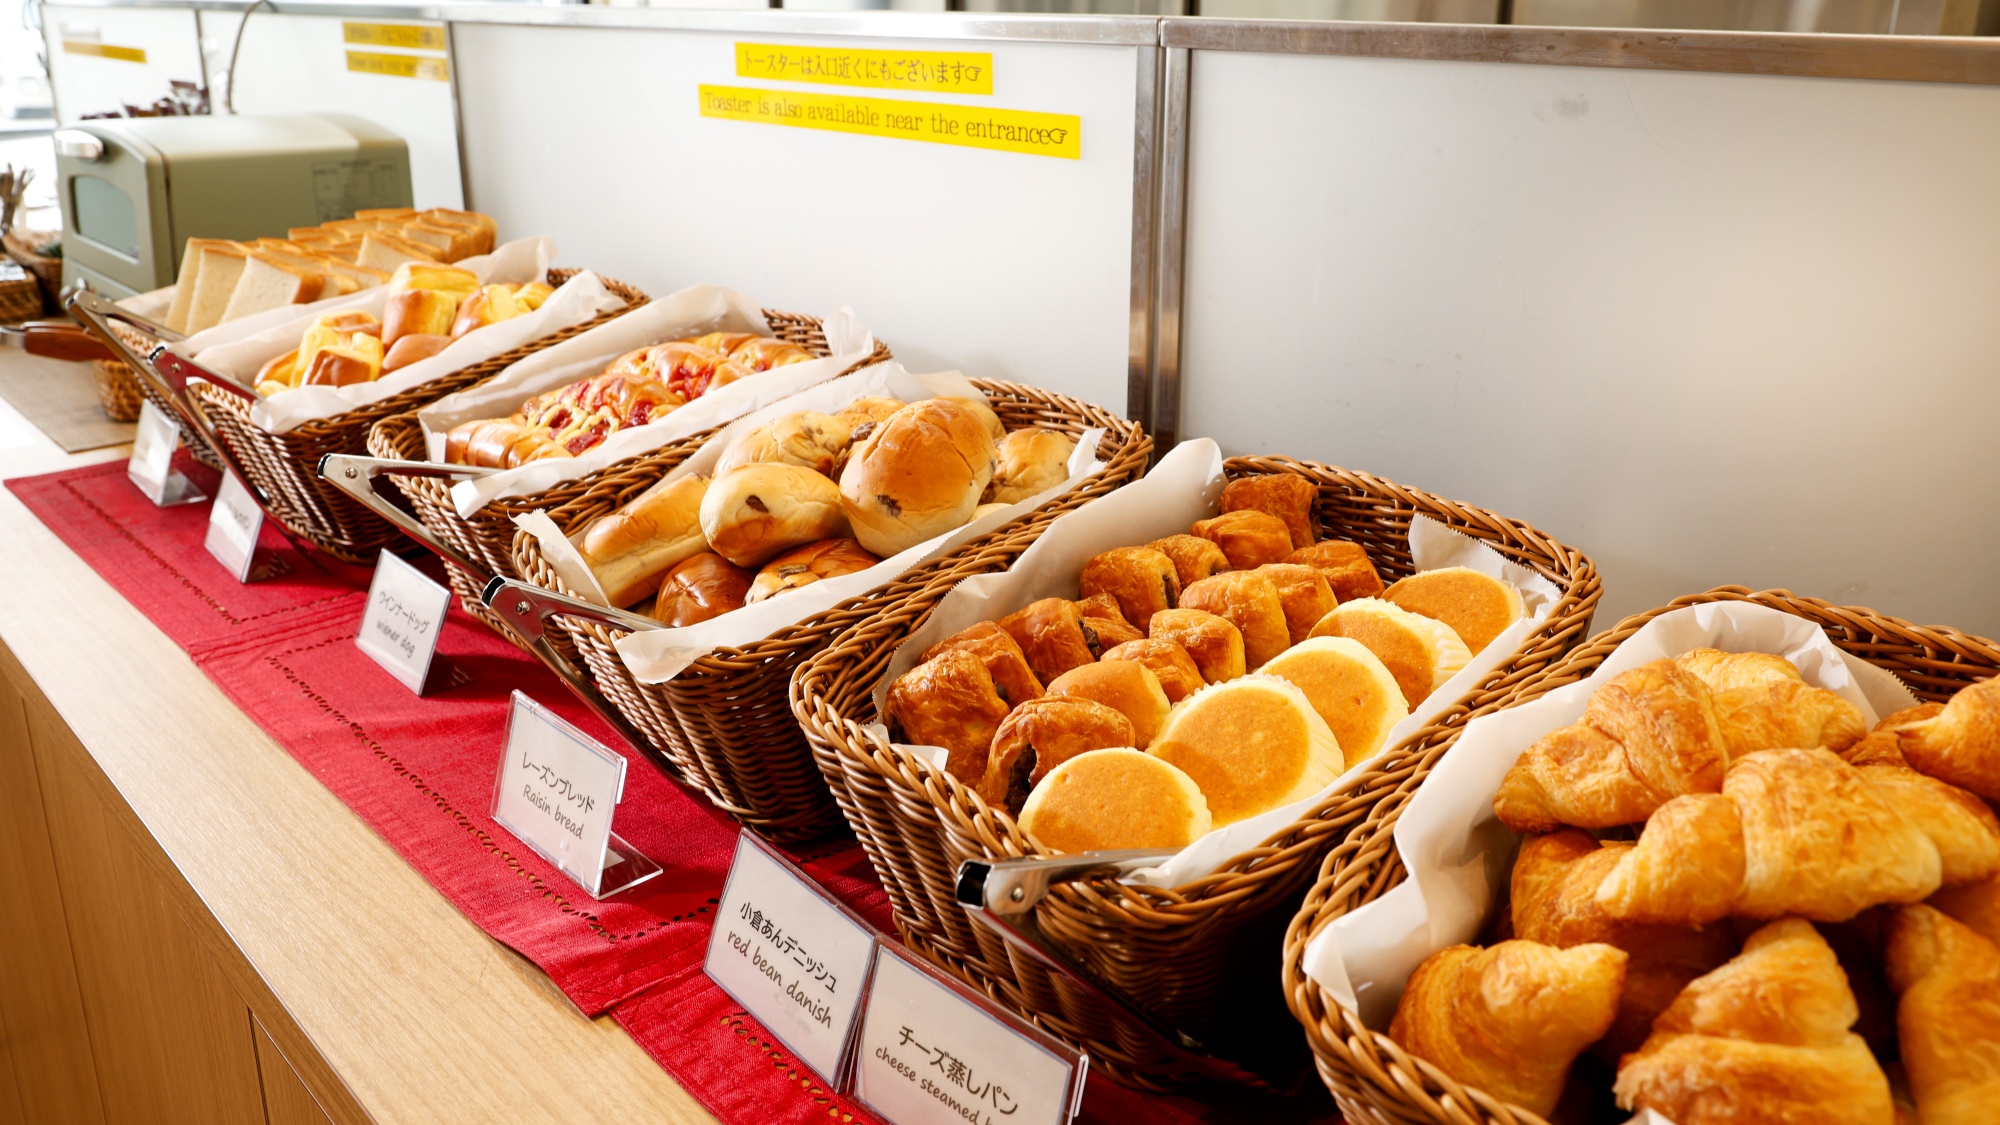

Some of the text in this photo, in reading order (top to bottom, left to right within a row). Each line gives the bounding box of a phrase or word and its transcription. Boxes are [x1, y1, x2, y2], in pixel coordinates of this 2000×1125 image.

[745, 50, 965, 85] トースターは入口近くにもございます
[704, 91, 1050, 145] Toaster is also available near the entrance
[376, 619, 416, 659] wiener dog
[522, 751, 595, 814] レーズンブレッド
[523, 784, 585, 840] Raisin bread
[727, 930, 832, 1029] red bean danish
[740, 902, 837, 994] 小倉あんデニッシュ
[875, 1047, 981, 1125] cheese steamed
[899, 1025, 1019, 1115] チーズ蒸しパン
